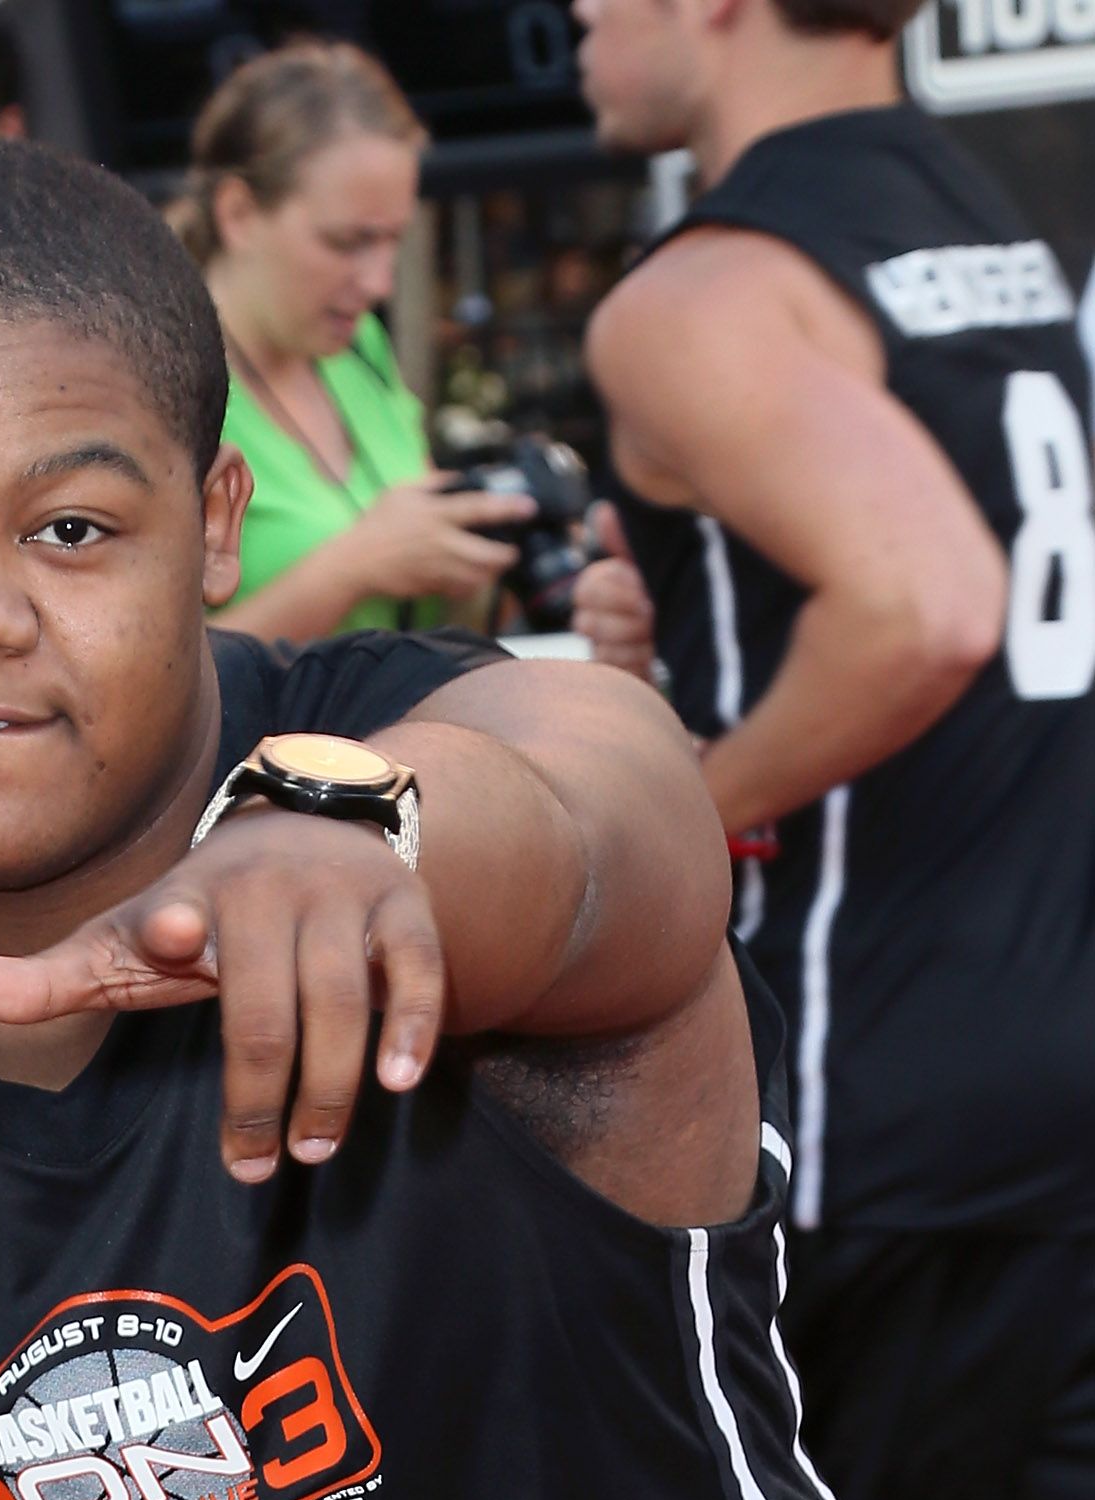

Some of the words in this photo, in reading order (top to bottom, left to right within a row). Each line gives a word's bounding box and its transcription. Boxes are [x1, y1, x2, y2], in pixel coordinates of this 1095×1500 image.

[1003, 370, 1095, 700] 8
[117, 1314, 184, 1347] 8-10
[240, 1355, 347, 1491] 3
[365, 1474, 384, 1492] BY
